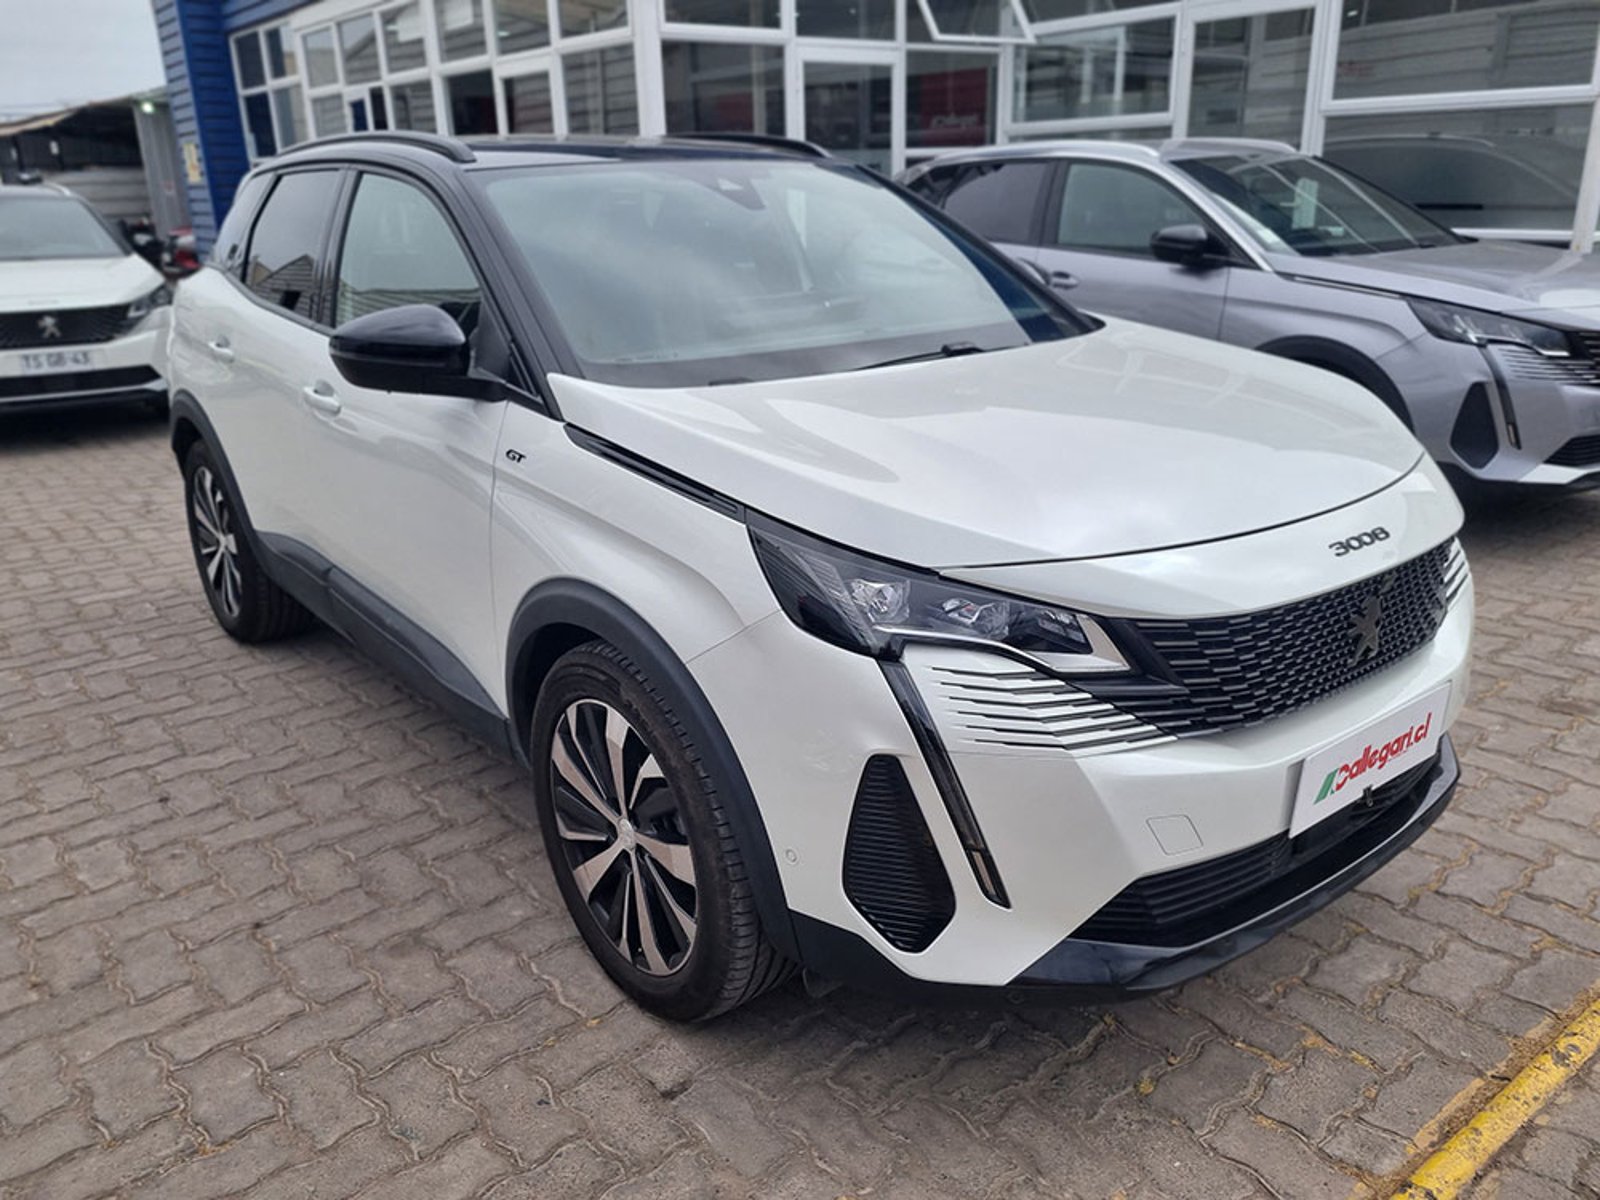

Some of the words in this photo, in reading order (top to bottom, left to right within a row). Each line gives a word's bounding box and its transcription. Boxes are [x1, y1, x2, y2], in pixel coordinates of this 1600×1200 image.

[505, 448, 527, 463] GT
[1328, 526, 1391, 557] 3008
[1335, 712, 1433, 792] Callegari.cl
